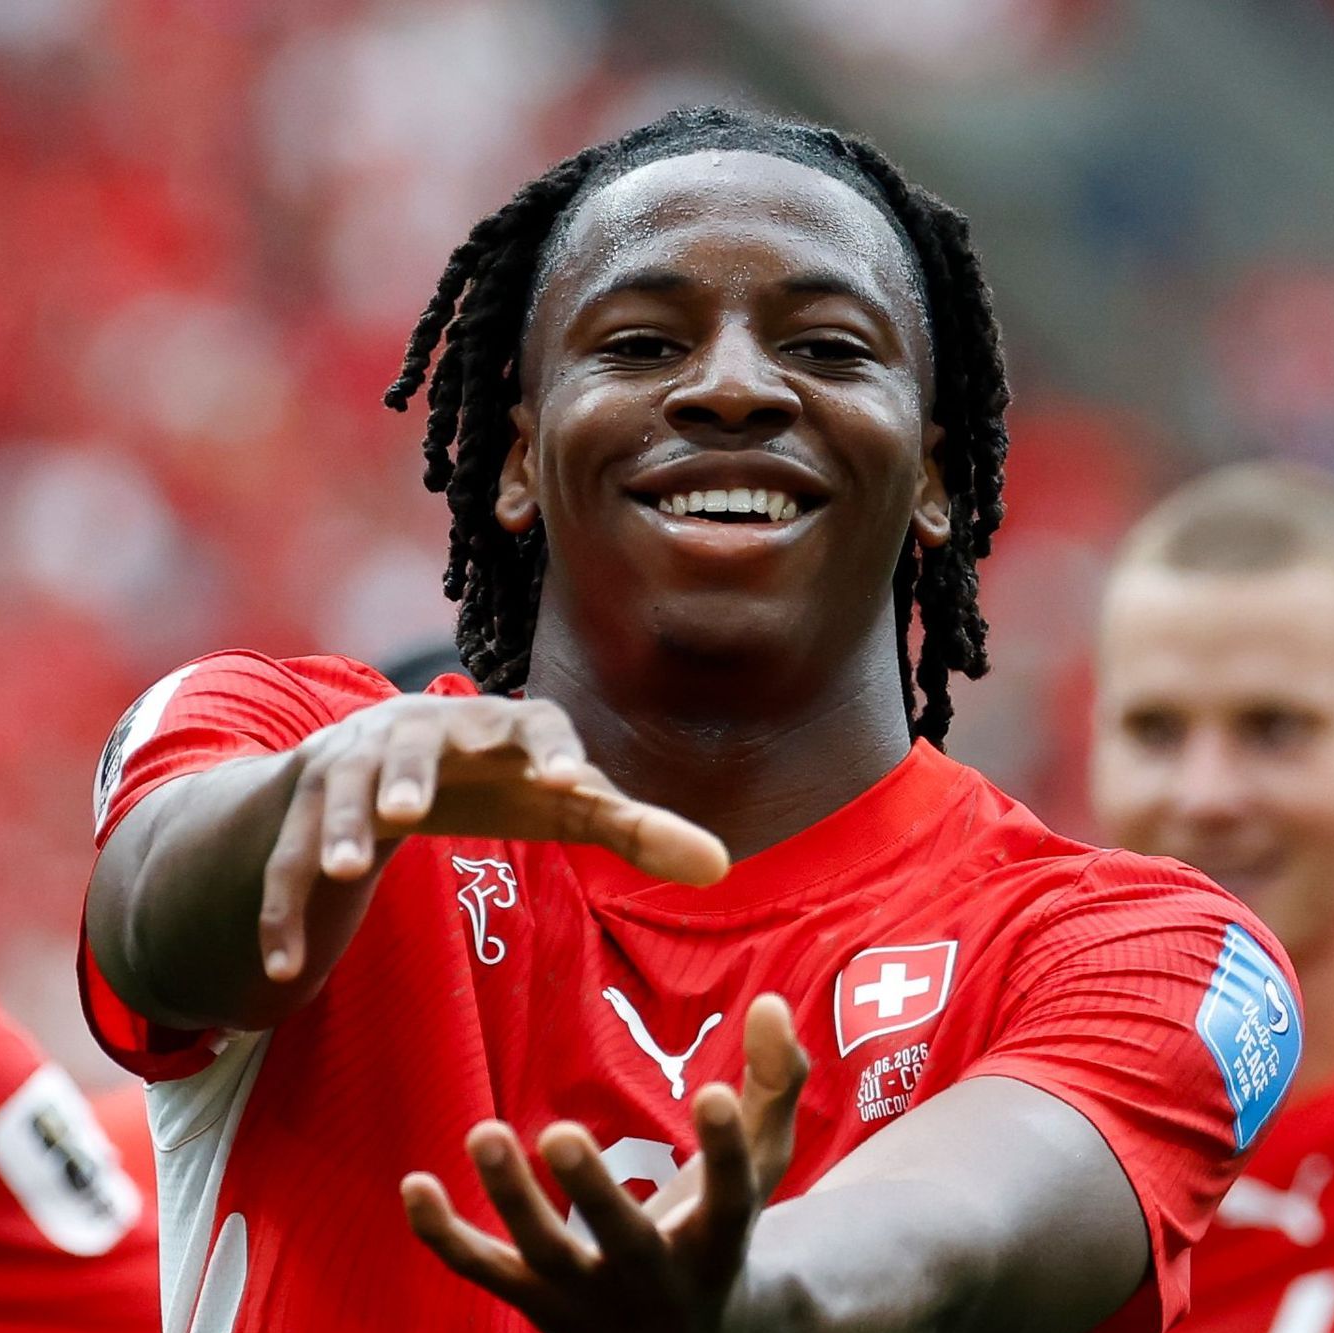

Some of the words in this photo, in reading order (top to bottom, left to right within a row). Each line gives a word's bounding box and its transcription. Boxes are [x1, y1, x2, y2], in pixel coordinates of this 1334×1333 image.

[1234, 1022, 1269, 1101] PEACE
[1234, 1057, 1251, 1100] FIFA
[856, 1076, 882, 1107] SUI
